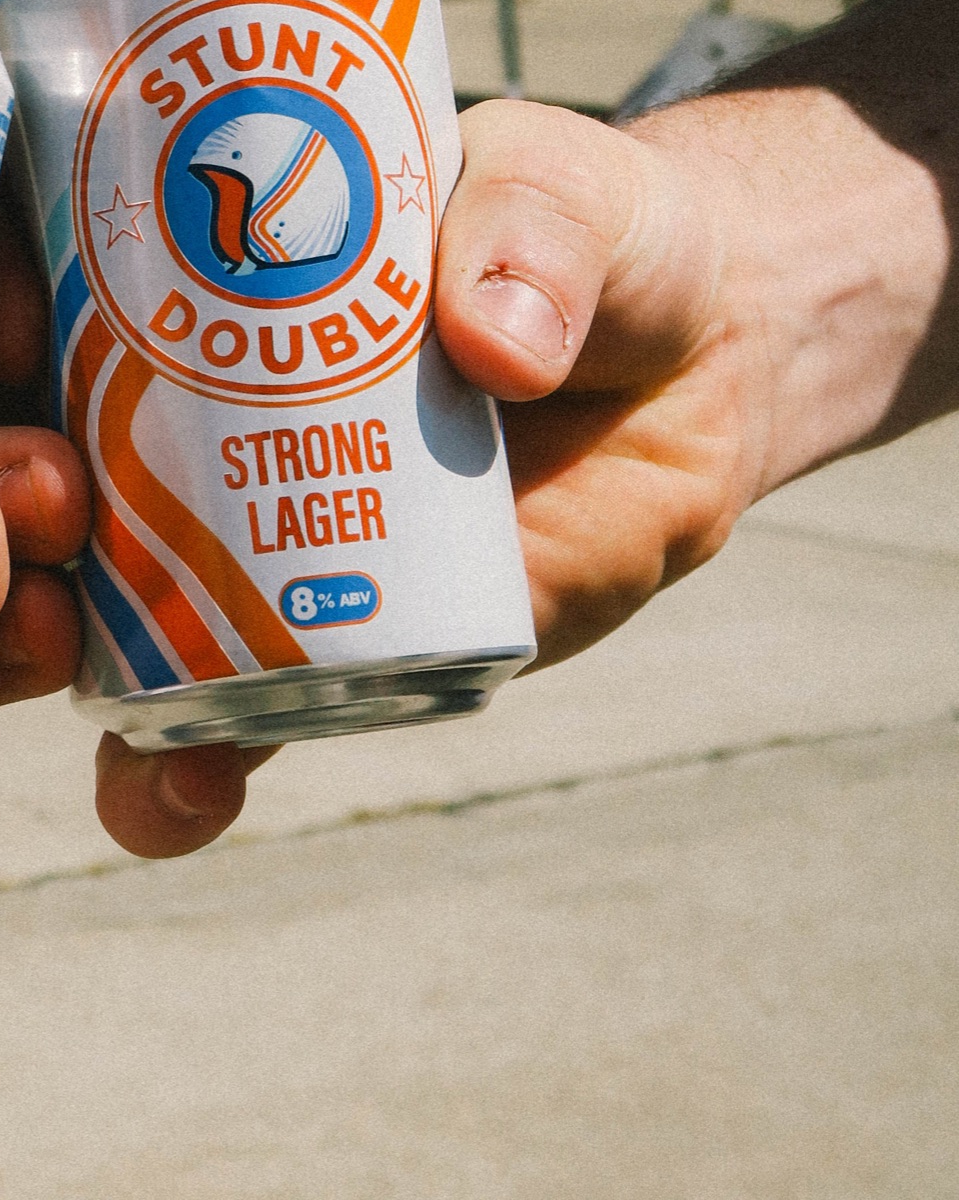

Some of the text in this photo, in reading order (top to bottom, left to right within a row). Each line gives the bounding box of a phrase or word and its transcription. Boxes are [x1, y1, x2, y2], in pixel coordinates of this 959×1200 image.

[140, 22, 366, 120] STUNT
[147, 257, 422, 375] DOUBLE
[220, 418, 392, 490] STRONG
[247, 487, 387, 555] LAGER
[339, 591, 371, 609] ABV
